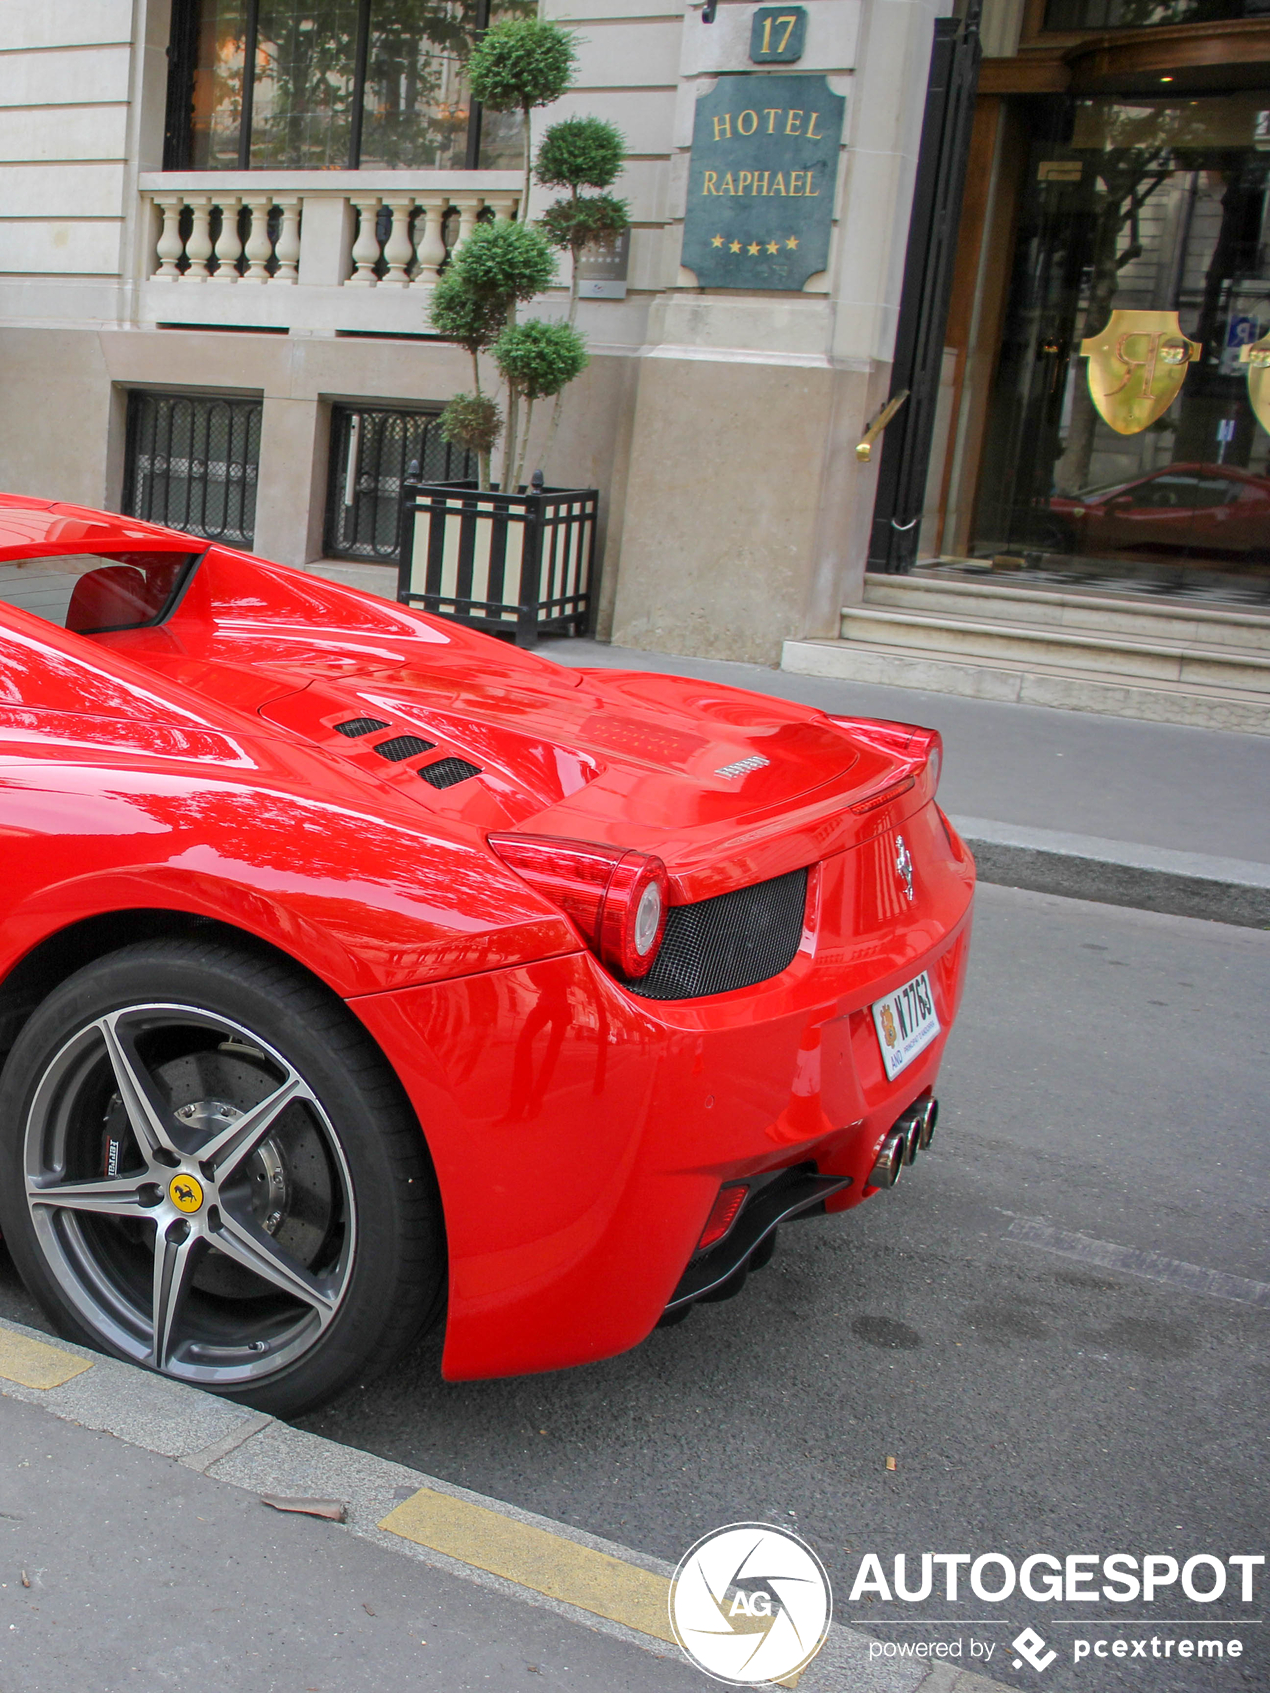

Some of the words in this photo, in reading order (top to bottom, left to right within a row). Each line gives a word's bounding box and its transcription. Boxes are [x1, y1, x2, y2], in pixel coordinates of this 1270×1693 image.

[760, 16, 797, 53] 17
[713, 109, 823, 141] HOTEL
[702, 171, 820, 196] RAPHAEL
[890, 1049, 903, 1071] AND
